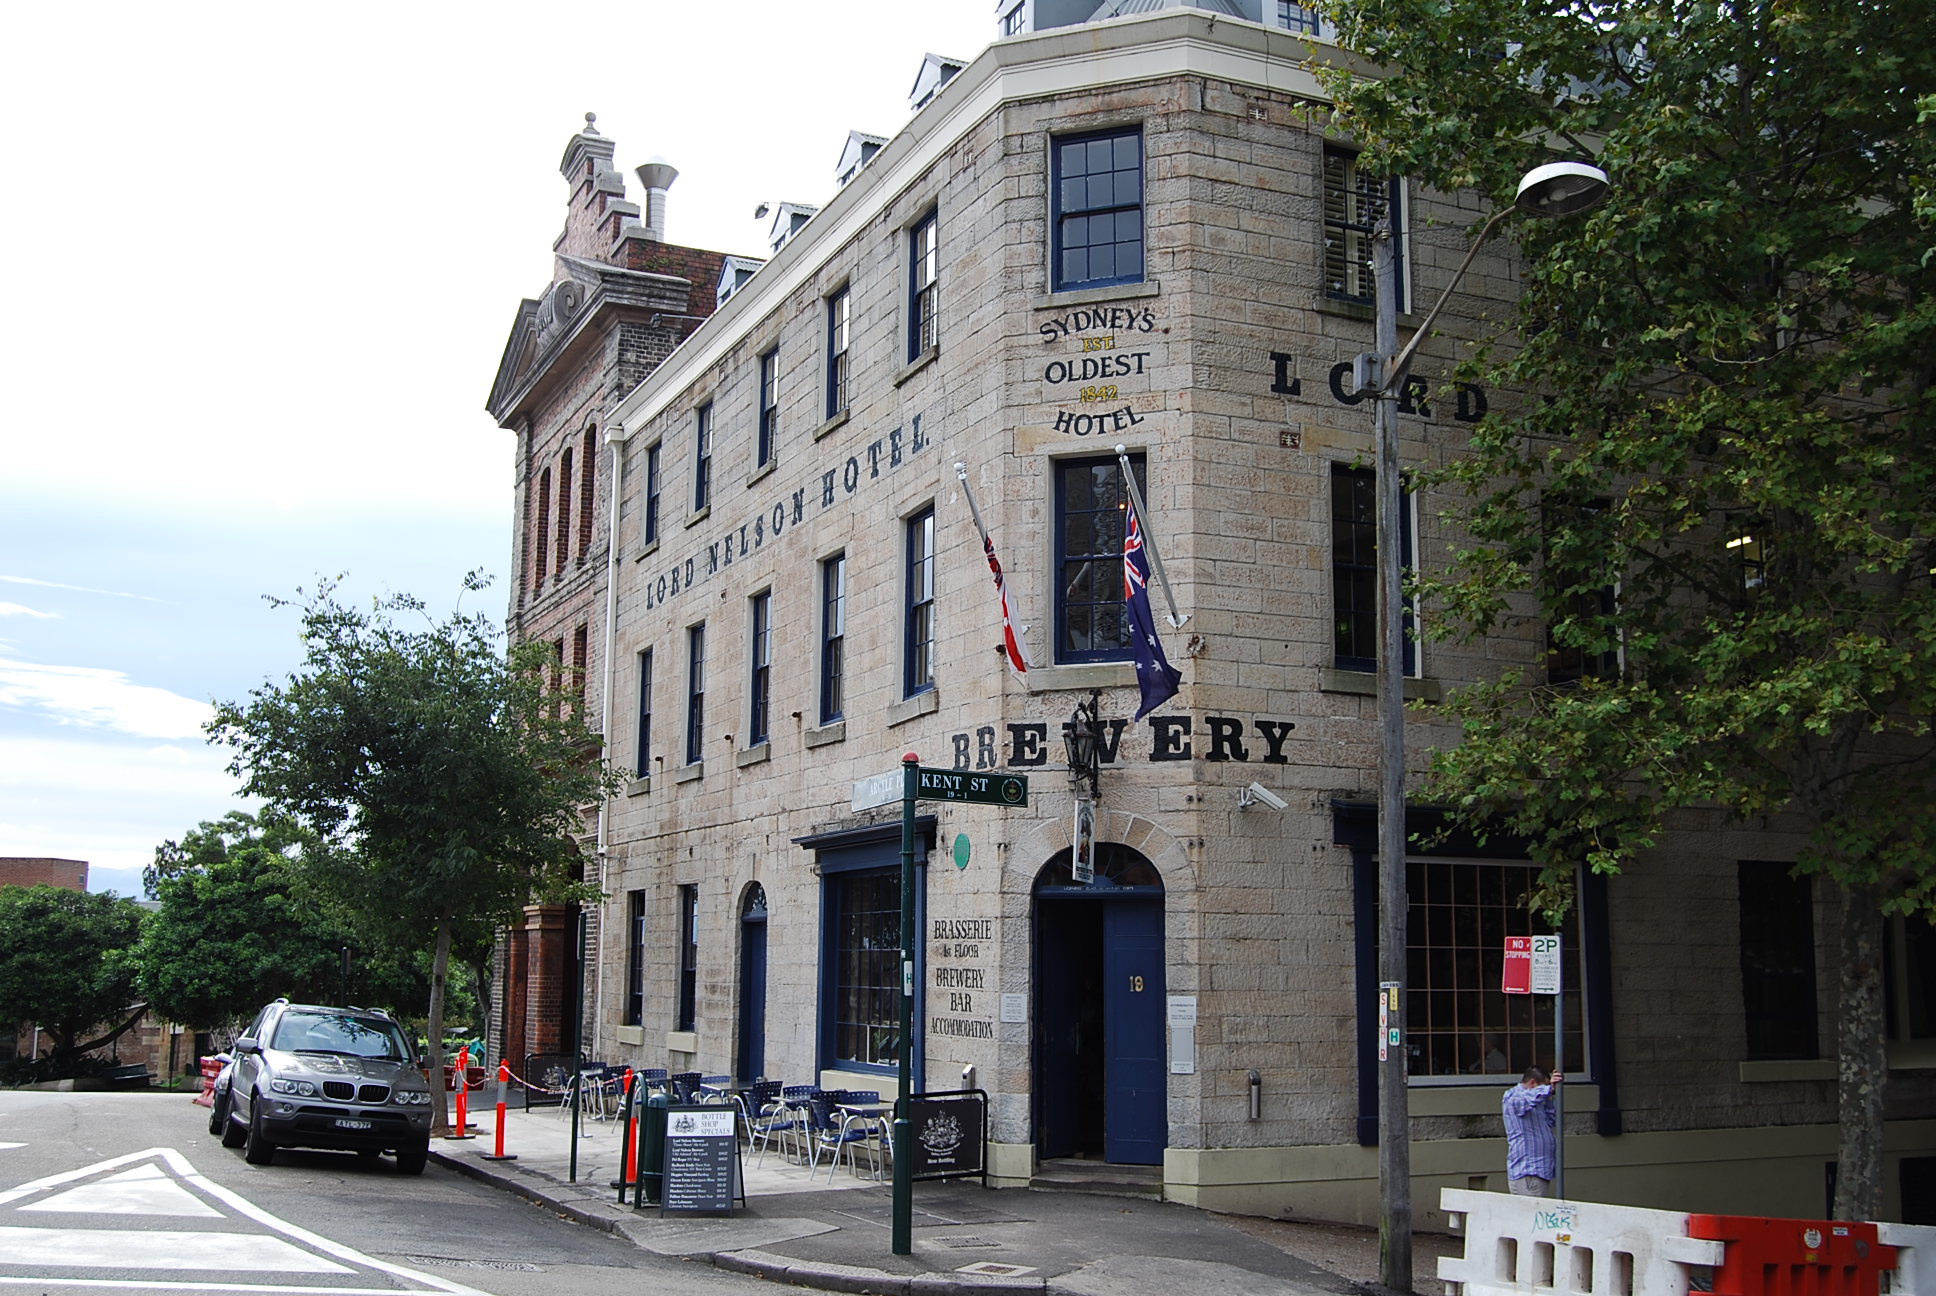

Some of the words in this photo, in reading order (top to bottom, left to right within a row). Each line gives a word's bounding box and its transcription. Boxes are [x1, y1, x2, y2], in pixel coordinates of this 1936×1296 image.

[1039, 307, 1156, 344] SYDNEY'S
[1044, 351, 1151, 384] OLDEST
[1079, 384, 1119, 403] 1842
[1052, 405, 1145, 436] HOTEL
[646, 557, 694, 610] LORD
[708, 487, 804, 575] NELSON
[869, 777, 893, 796] ARGYLE
[921, 773, 963, 790] KENT
[970, 777, 989, 792] ST
[933, 919, 992, 940] BRASSERIE
[953, 943, 979, 958] FLOOR
[1512, 939, 1524, 949] NO
[1534, 939, 1558, 953] 2P
[1505, 951, 1531, 959] STOPPING
[935, 967, 985, 989] BREWERY
[950, 992, 972, 1013] BAR
[930, 1017, 993, 1039] ACCOMMODATION
[1390, 1031, 1399, 1043] H
